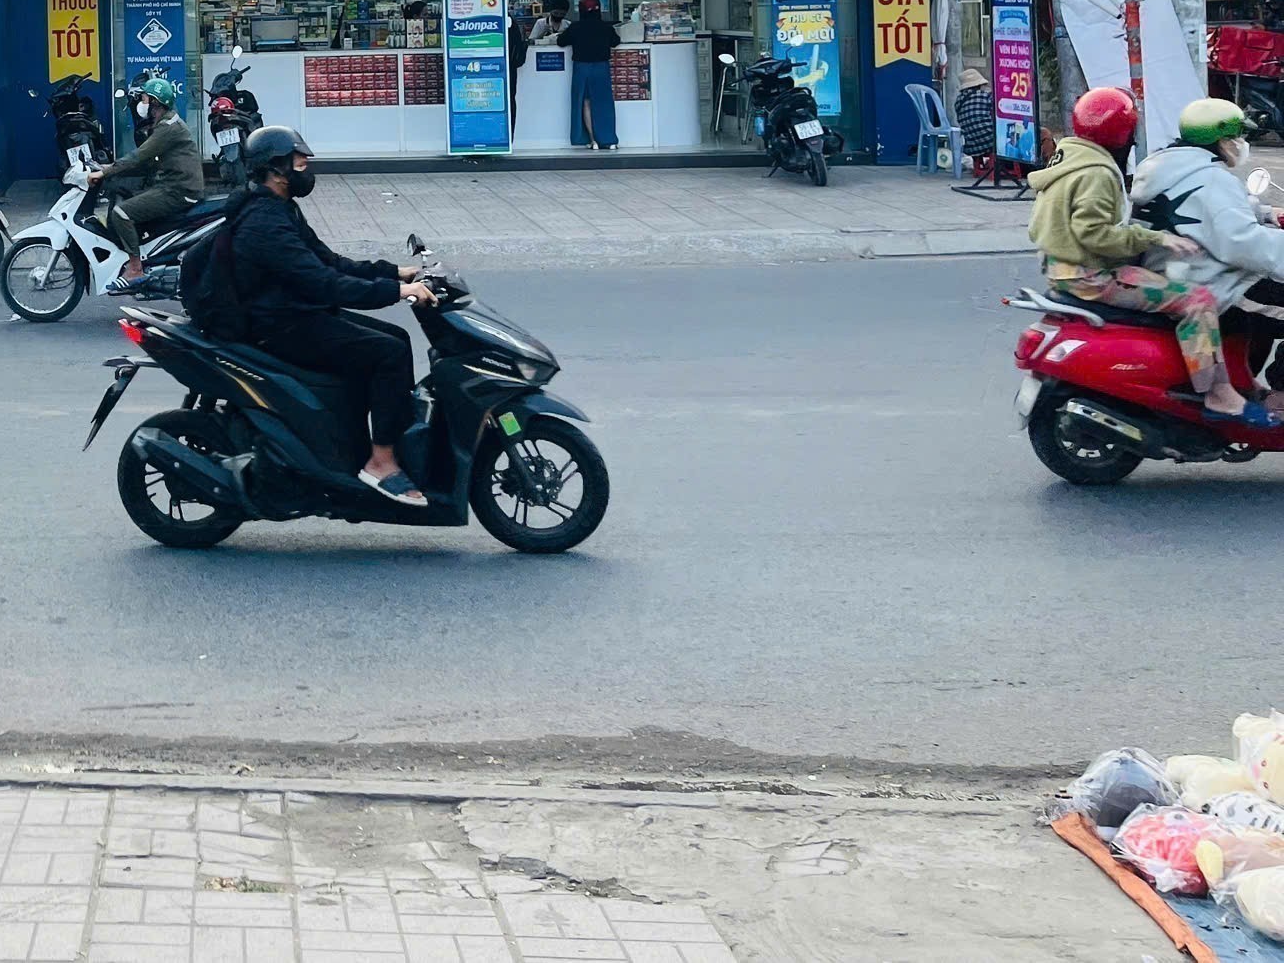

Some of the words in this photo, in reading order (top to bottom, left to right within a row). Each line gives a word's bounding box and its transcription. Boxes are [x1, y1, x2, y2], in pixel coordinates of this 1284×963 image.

[52, 16, 95, 58] TỐT
[453, 20, 499, 32] Salonpas
[877, 9, 928, 54] TỐT
